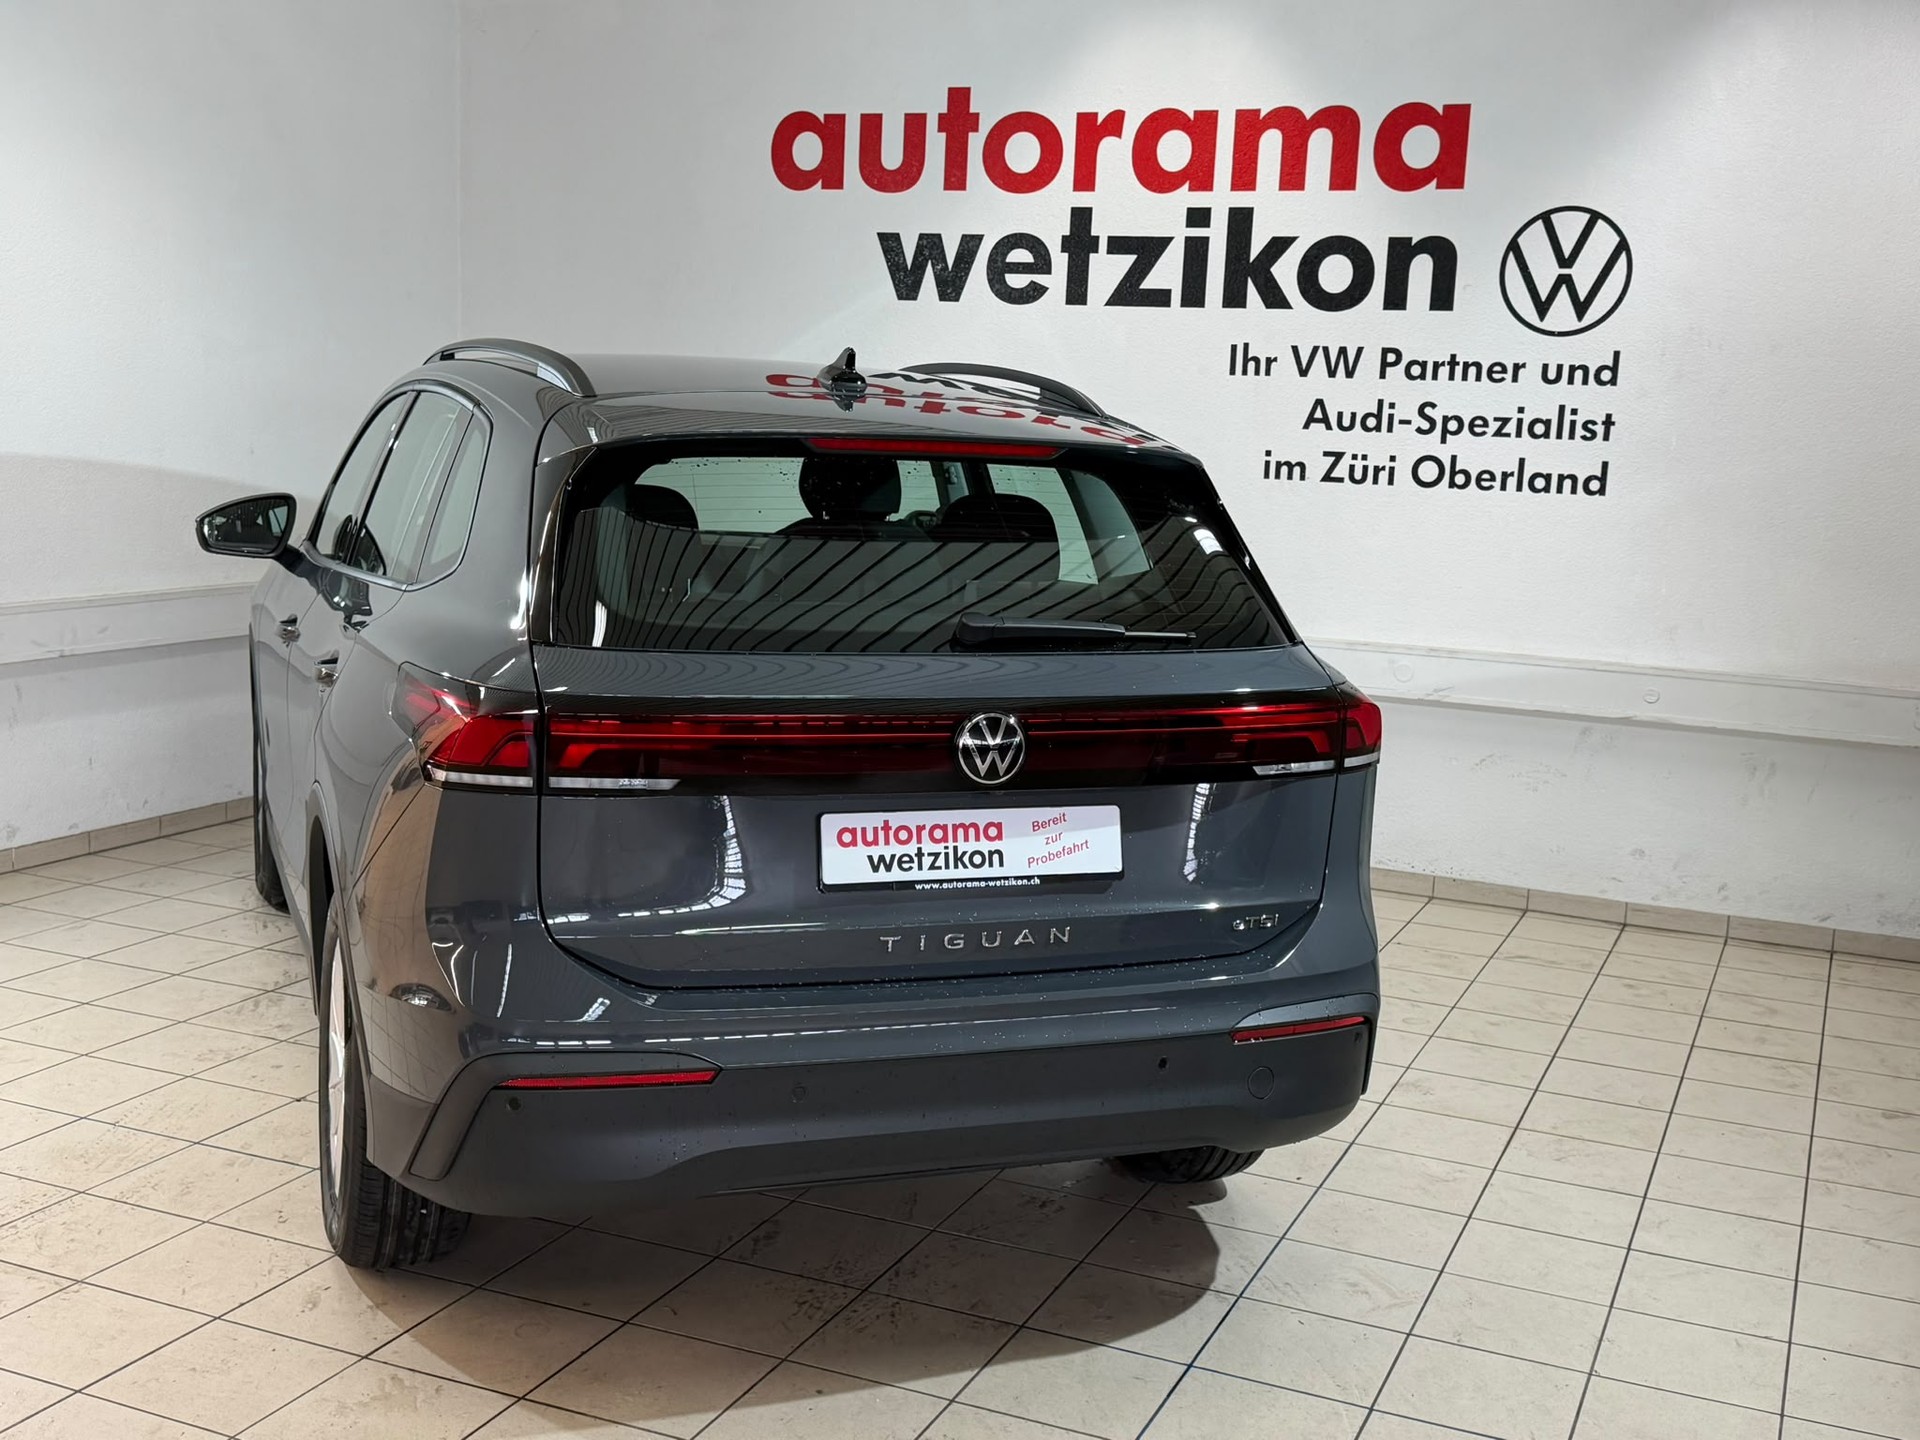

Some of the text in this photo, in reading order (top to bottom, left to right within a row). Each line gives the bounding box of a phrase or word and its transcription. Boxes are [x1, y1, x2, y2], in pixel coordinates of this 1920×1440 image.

[770, 86, 1472, 194] autorama
[876, 206, 1459, 312] wetzikon
[1228, 342, 1621, 387] Ihr VW Partner und
[1302, 398, 1616, 445] Audi-Spezialist
[1263, 450, 1610, 497] im Züri Oberland
[836, 819, 1004, 848] autorama
[1031, 812, 1068, 833] Bereit
[1044, 830, 1064, 846] zur
[866, 846, 1005, 874] wetzikon
[1027, 838, 1091, 869] Probefahrt
[914, 876, 1041, 891] www.autorama-wetzikon.ch
[879, 926, 1071, 952] TIGUAN
